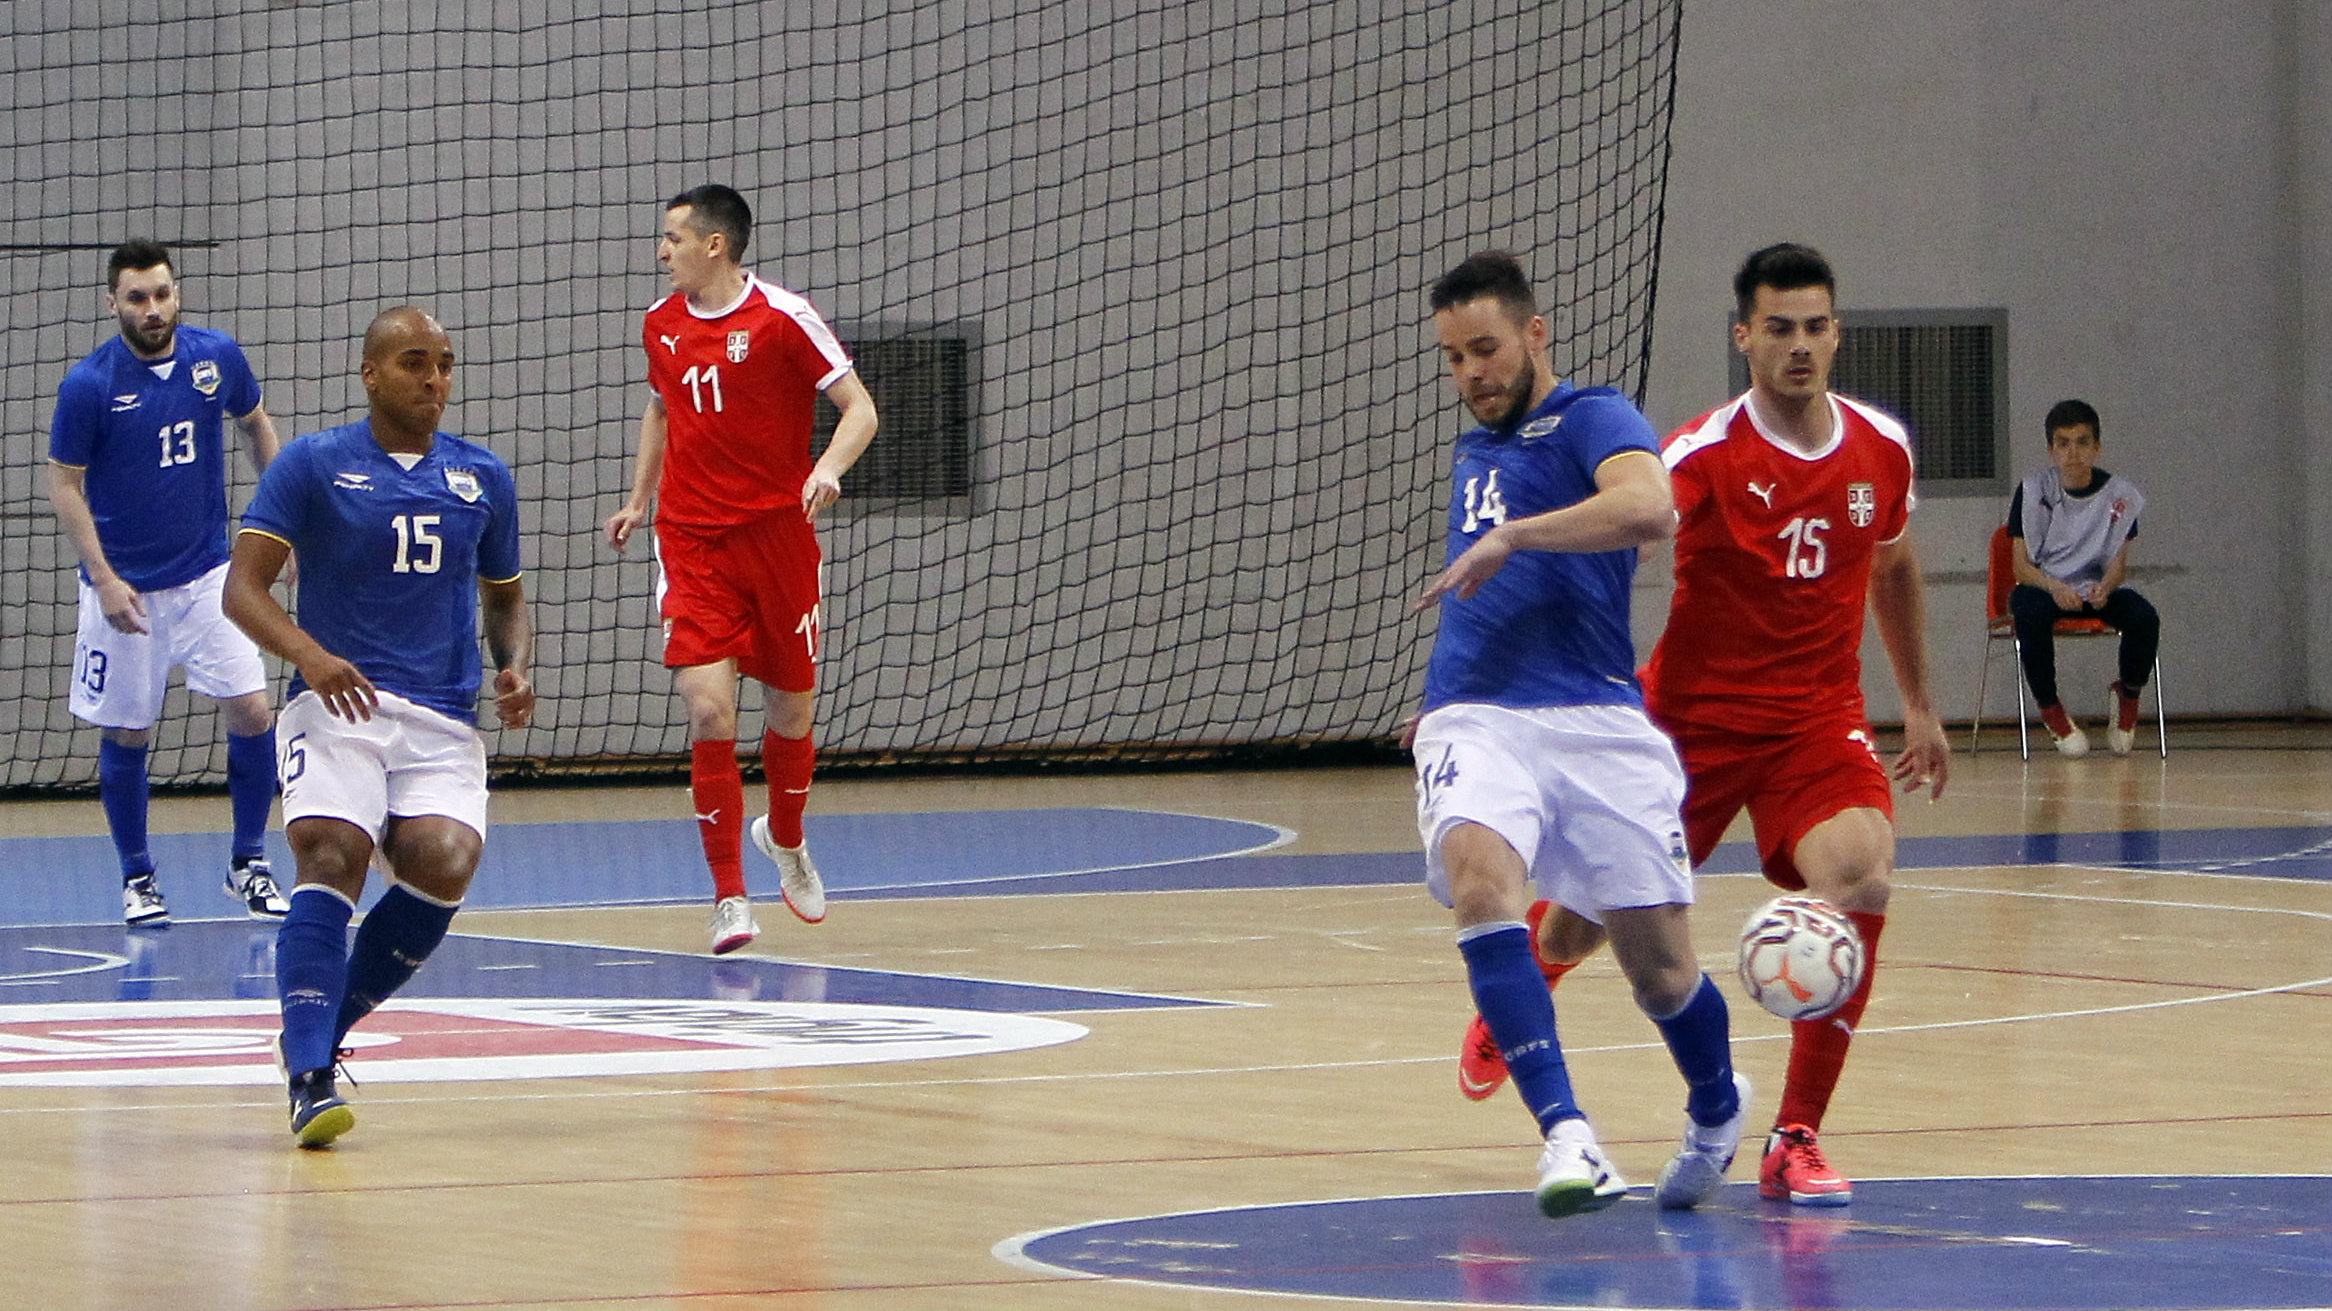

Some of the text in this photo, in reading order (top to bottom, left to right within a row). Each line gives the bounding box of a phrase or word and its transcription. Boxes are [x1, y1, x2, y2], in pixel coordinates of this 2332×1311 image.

[681, 365, 723, 413] 11
[158, 420, 197, 468] 13
[1461, 469, 1507, 534] 14
[391, 515, 443, 574] 15
[1777, 517, 1832, 579] 15
[795, 603, 820, 664] 11
[81, 645, 107, 694] 13
[1423, 742, 1459, 811] 14
